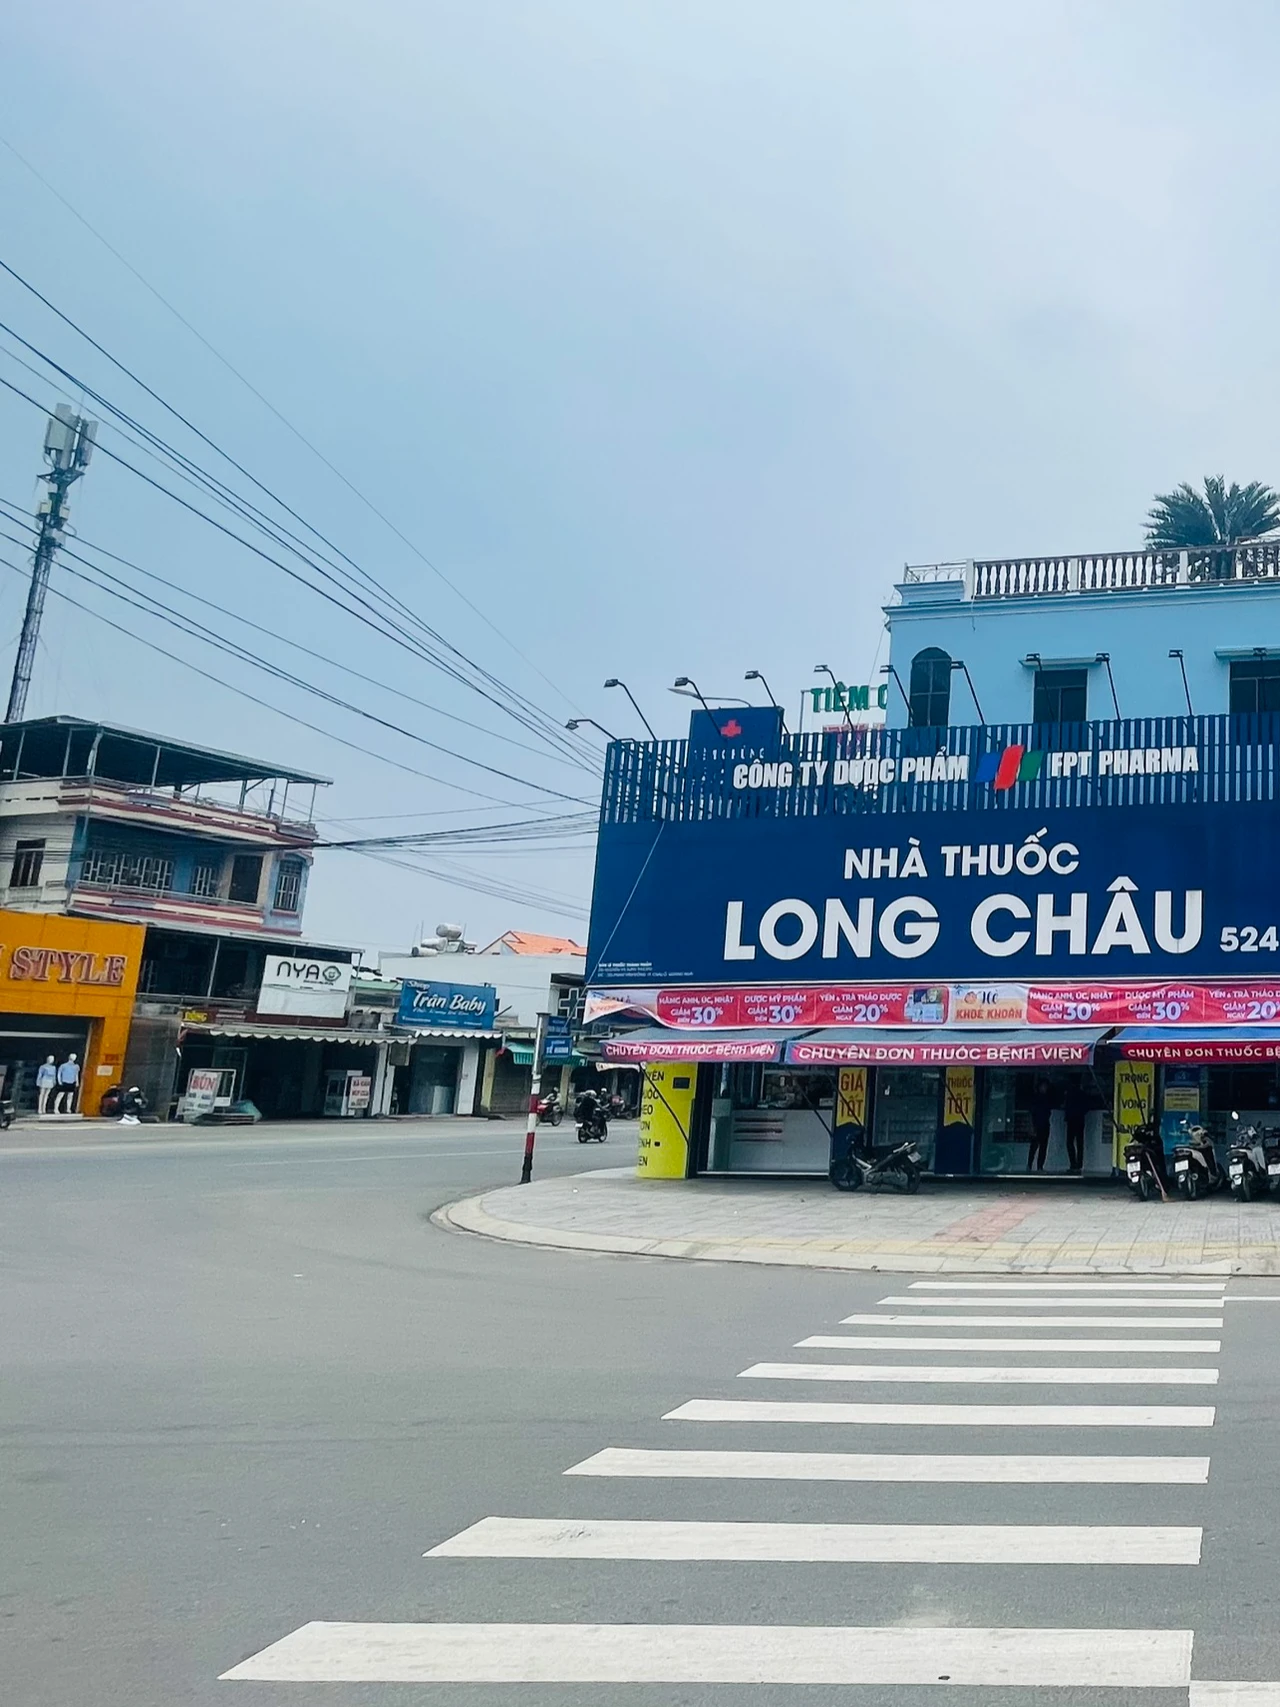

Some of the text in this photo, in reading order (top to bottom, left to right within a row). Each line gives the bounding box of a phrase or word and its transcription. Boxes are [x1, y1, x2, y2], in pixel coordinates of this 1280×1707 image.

[810, 681, 869, 713] TIÊM
[733, 745, 1199, 792] CÔNG TY DƯỢC PHẨM FPT PHARMA
[844, 827, 1080, 880] NHÀ THUỐC
[724, 876, 1280, 961] LONG CHÂU 524
[10, 946, 127, 987] STYLE
[449, 994, 487, 1016] Baby
[691, 1005, 723, 1024] 30%
[768, 1004, 802, 1023] 30%
[853, 1003, 889, 1022] 20%
[1063, 1002, 1100, 1021] 30%
[1152, 1001, 1189, 1020] 30%
[715, 1044, 747, 1057] BỆNH
[749, 1044, 775, 1056] VIỆN
[799, 1045, 1083, 1062] CHUYÊN ĐƠN THUỐC BỆNH VIỆN
[1127, 1045, 1181, 1059] CHUYÊN
[1184, 1046, 1214, 1058] ĐƠN
[1219, 1044, 1262, 1057] THUỐC
[840, 1072, 864, 1093] GIÁ
[1119, 1073, 1150, 1084] TRONG
